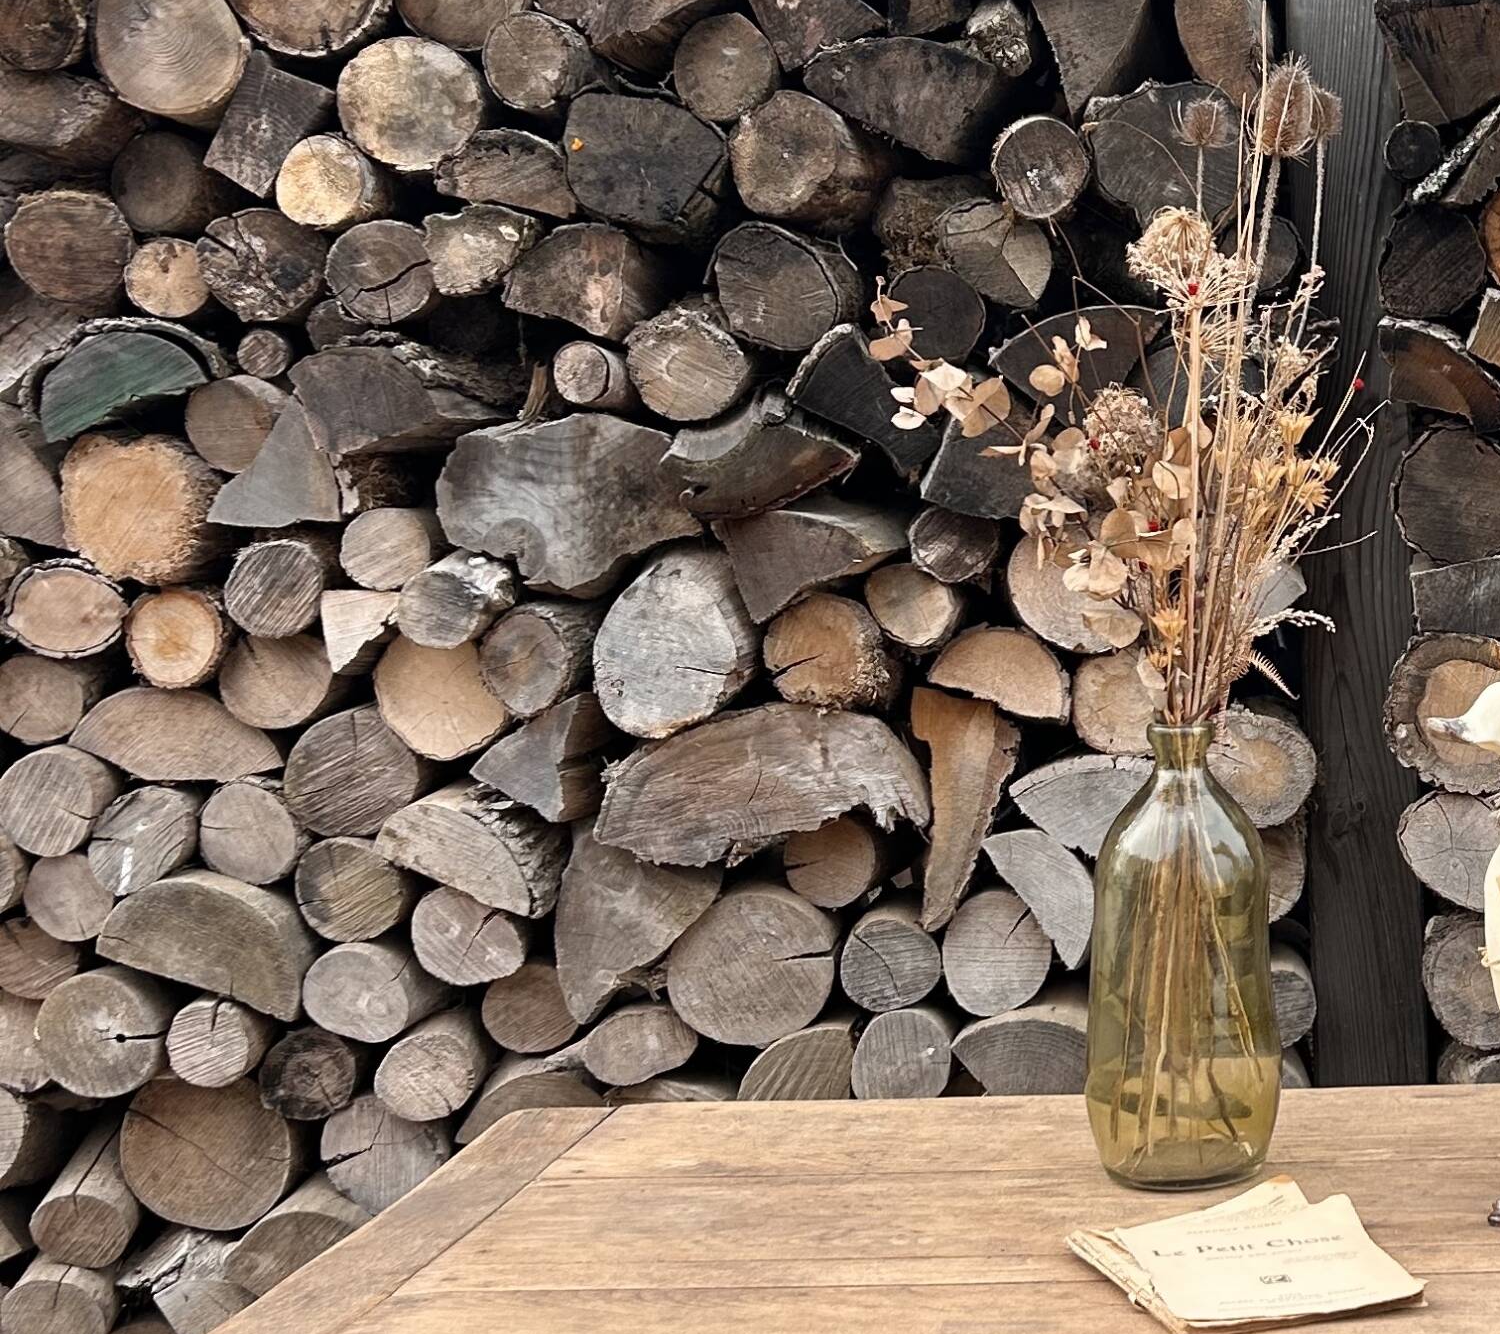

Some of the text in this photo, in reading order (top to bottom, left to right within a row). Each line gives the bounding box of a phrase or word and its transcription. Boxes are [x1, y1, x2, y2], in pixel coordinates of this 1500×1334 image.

[1152, 1249, 1186, 1257] Le
[1196, 1244, 1254, 1254] Petit
[1265, 1234, 1344, 1248] Chose
